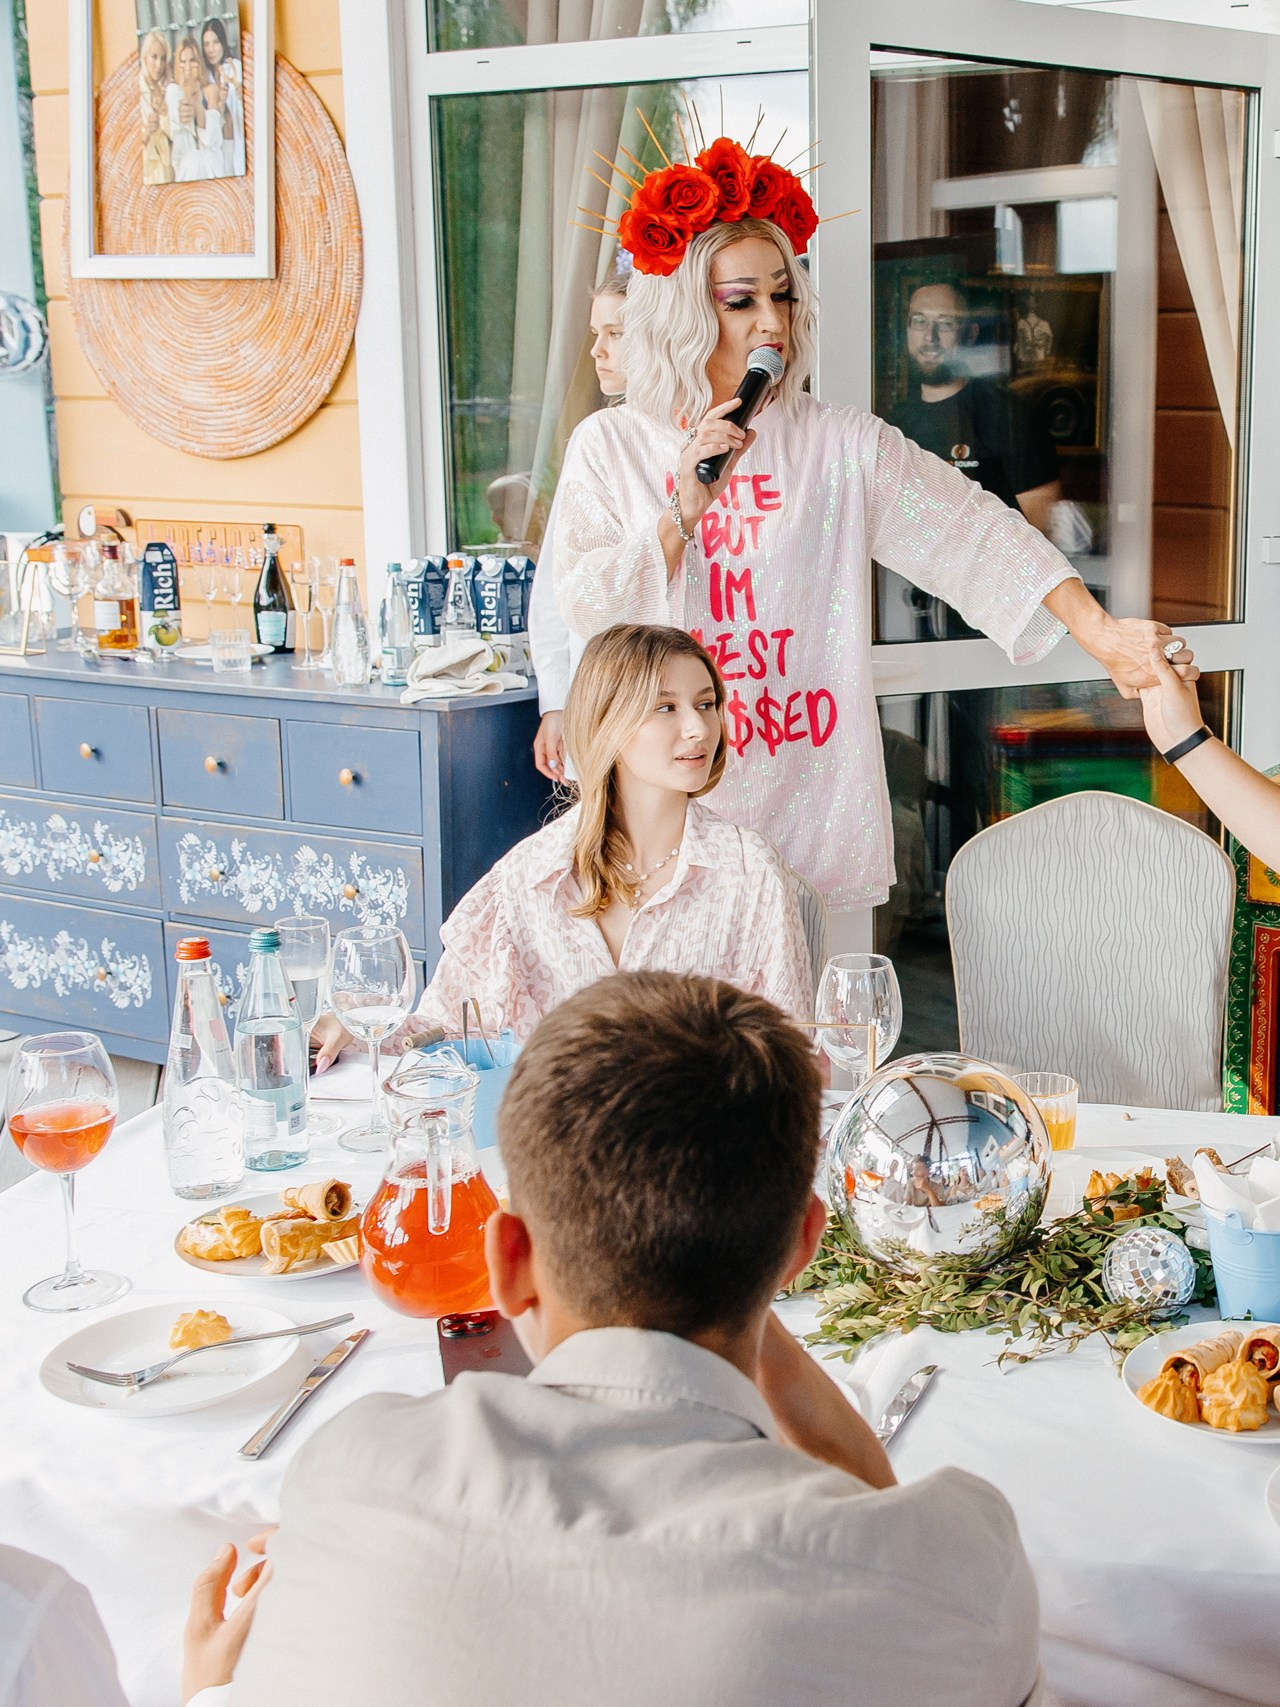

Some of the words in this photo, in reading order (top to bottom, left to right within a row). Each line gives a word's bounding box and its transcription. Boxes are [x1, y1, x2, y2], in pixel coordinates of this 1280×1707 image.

[701, 511, 765, 559] BUT
[152, 562, 175, 610] Rich
[481, 582, 497, 633] Rich
[709, 562, 757, 623] IM
